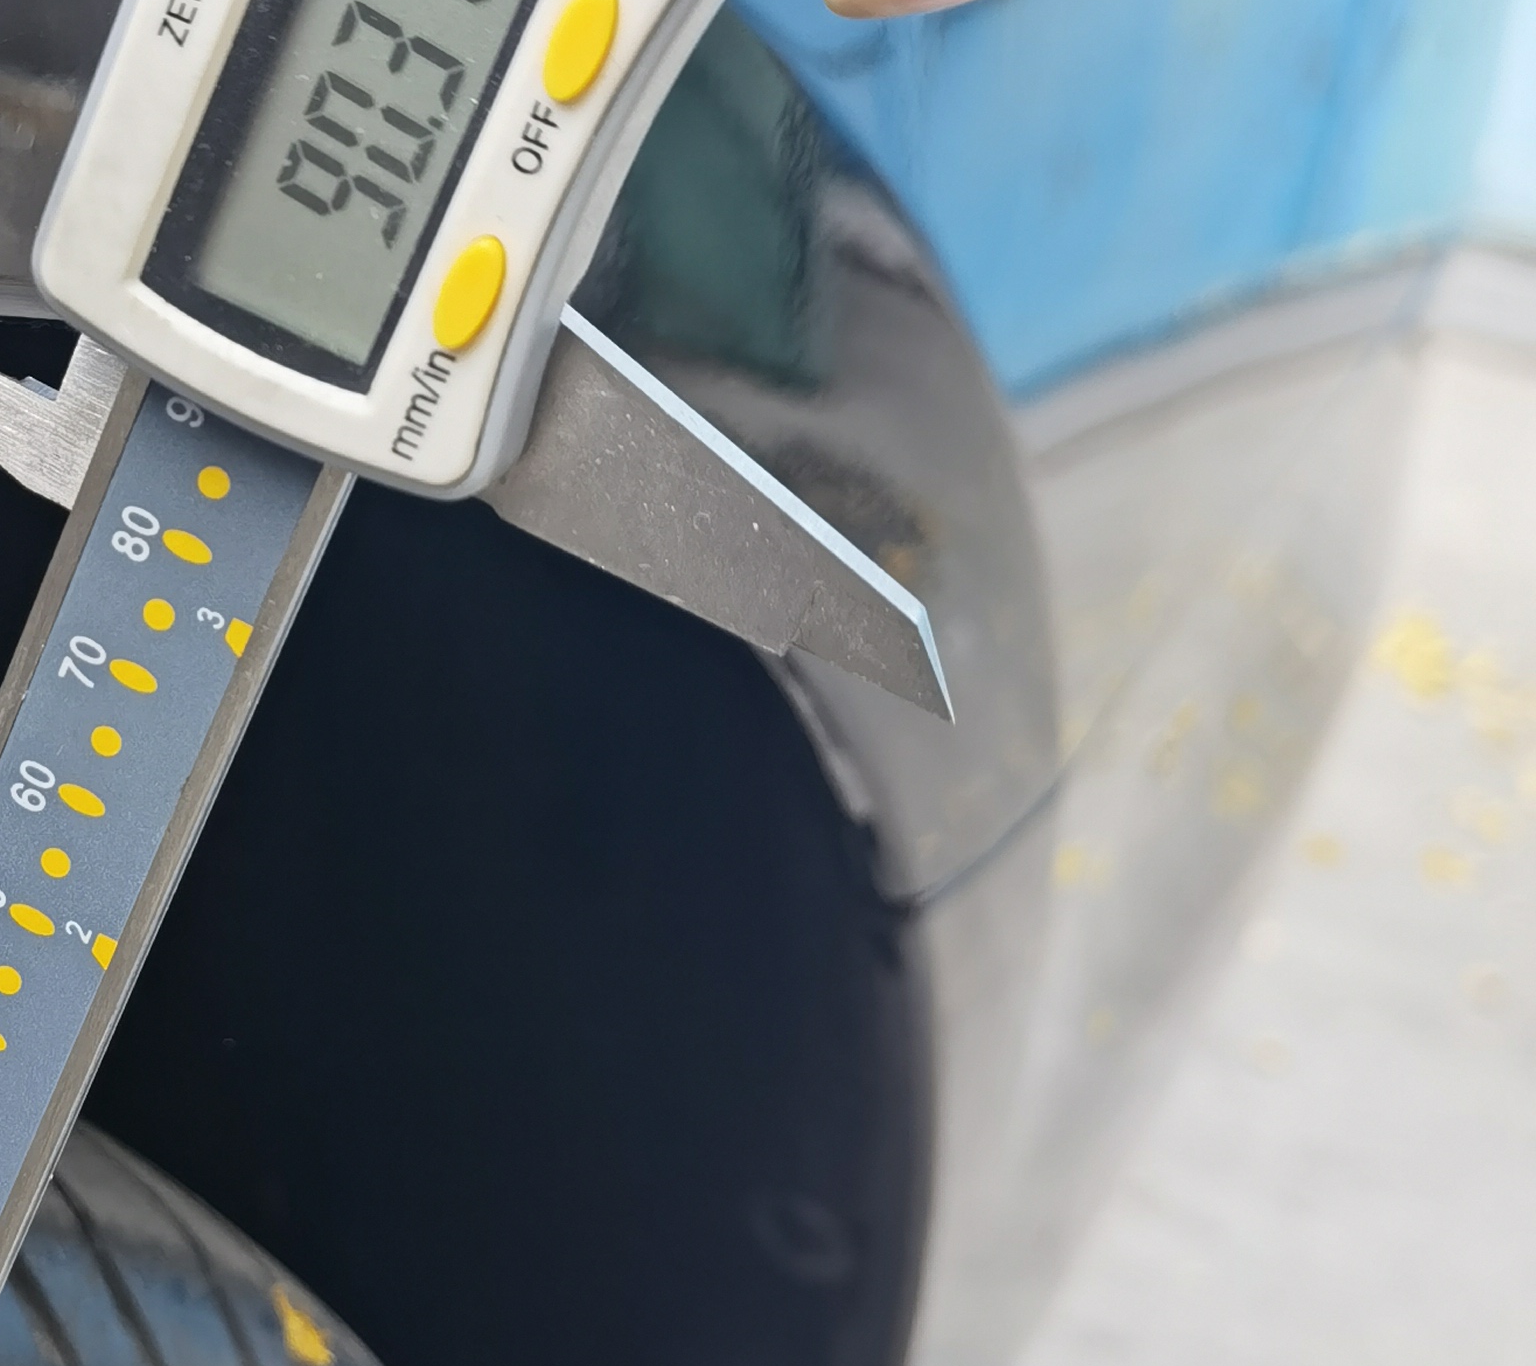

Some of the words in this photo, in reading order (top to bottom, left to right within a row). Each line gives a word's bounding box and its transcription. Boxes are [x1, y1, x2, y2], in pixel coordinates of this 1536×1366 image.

[511, 98, 562, 175] OFF
[390, 347, 458, 463] mm/in
[10, 759, 56, 813] 60
[58, 634, 107, 689] 70
[111, 505, 160, 562] 80
[166, 395, 206, 429] 9
[65, 919, 93, 945] 2
[196, 606, 226, 631] 3
